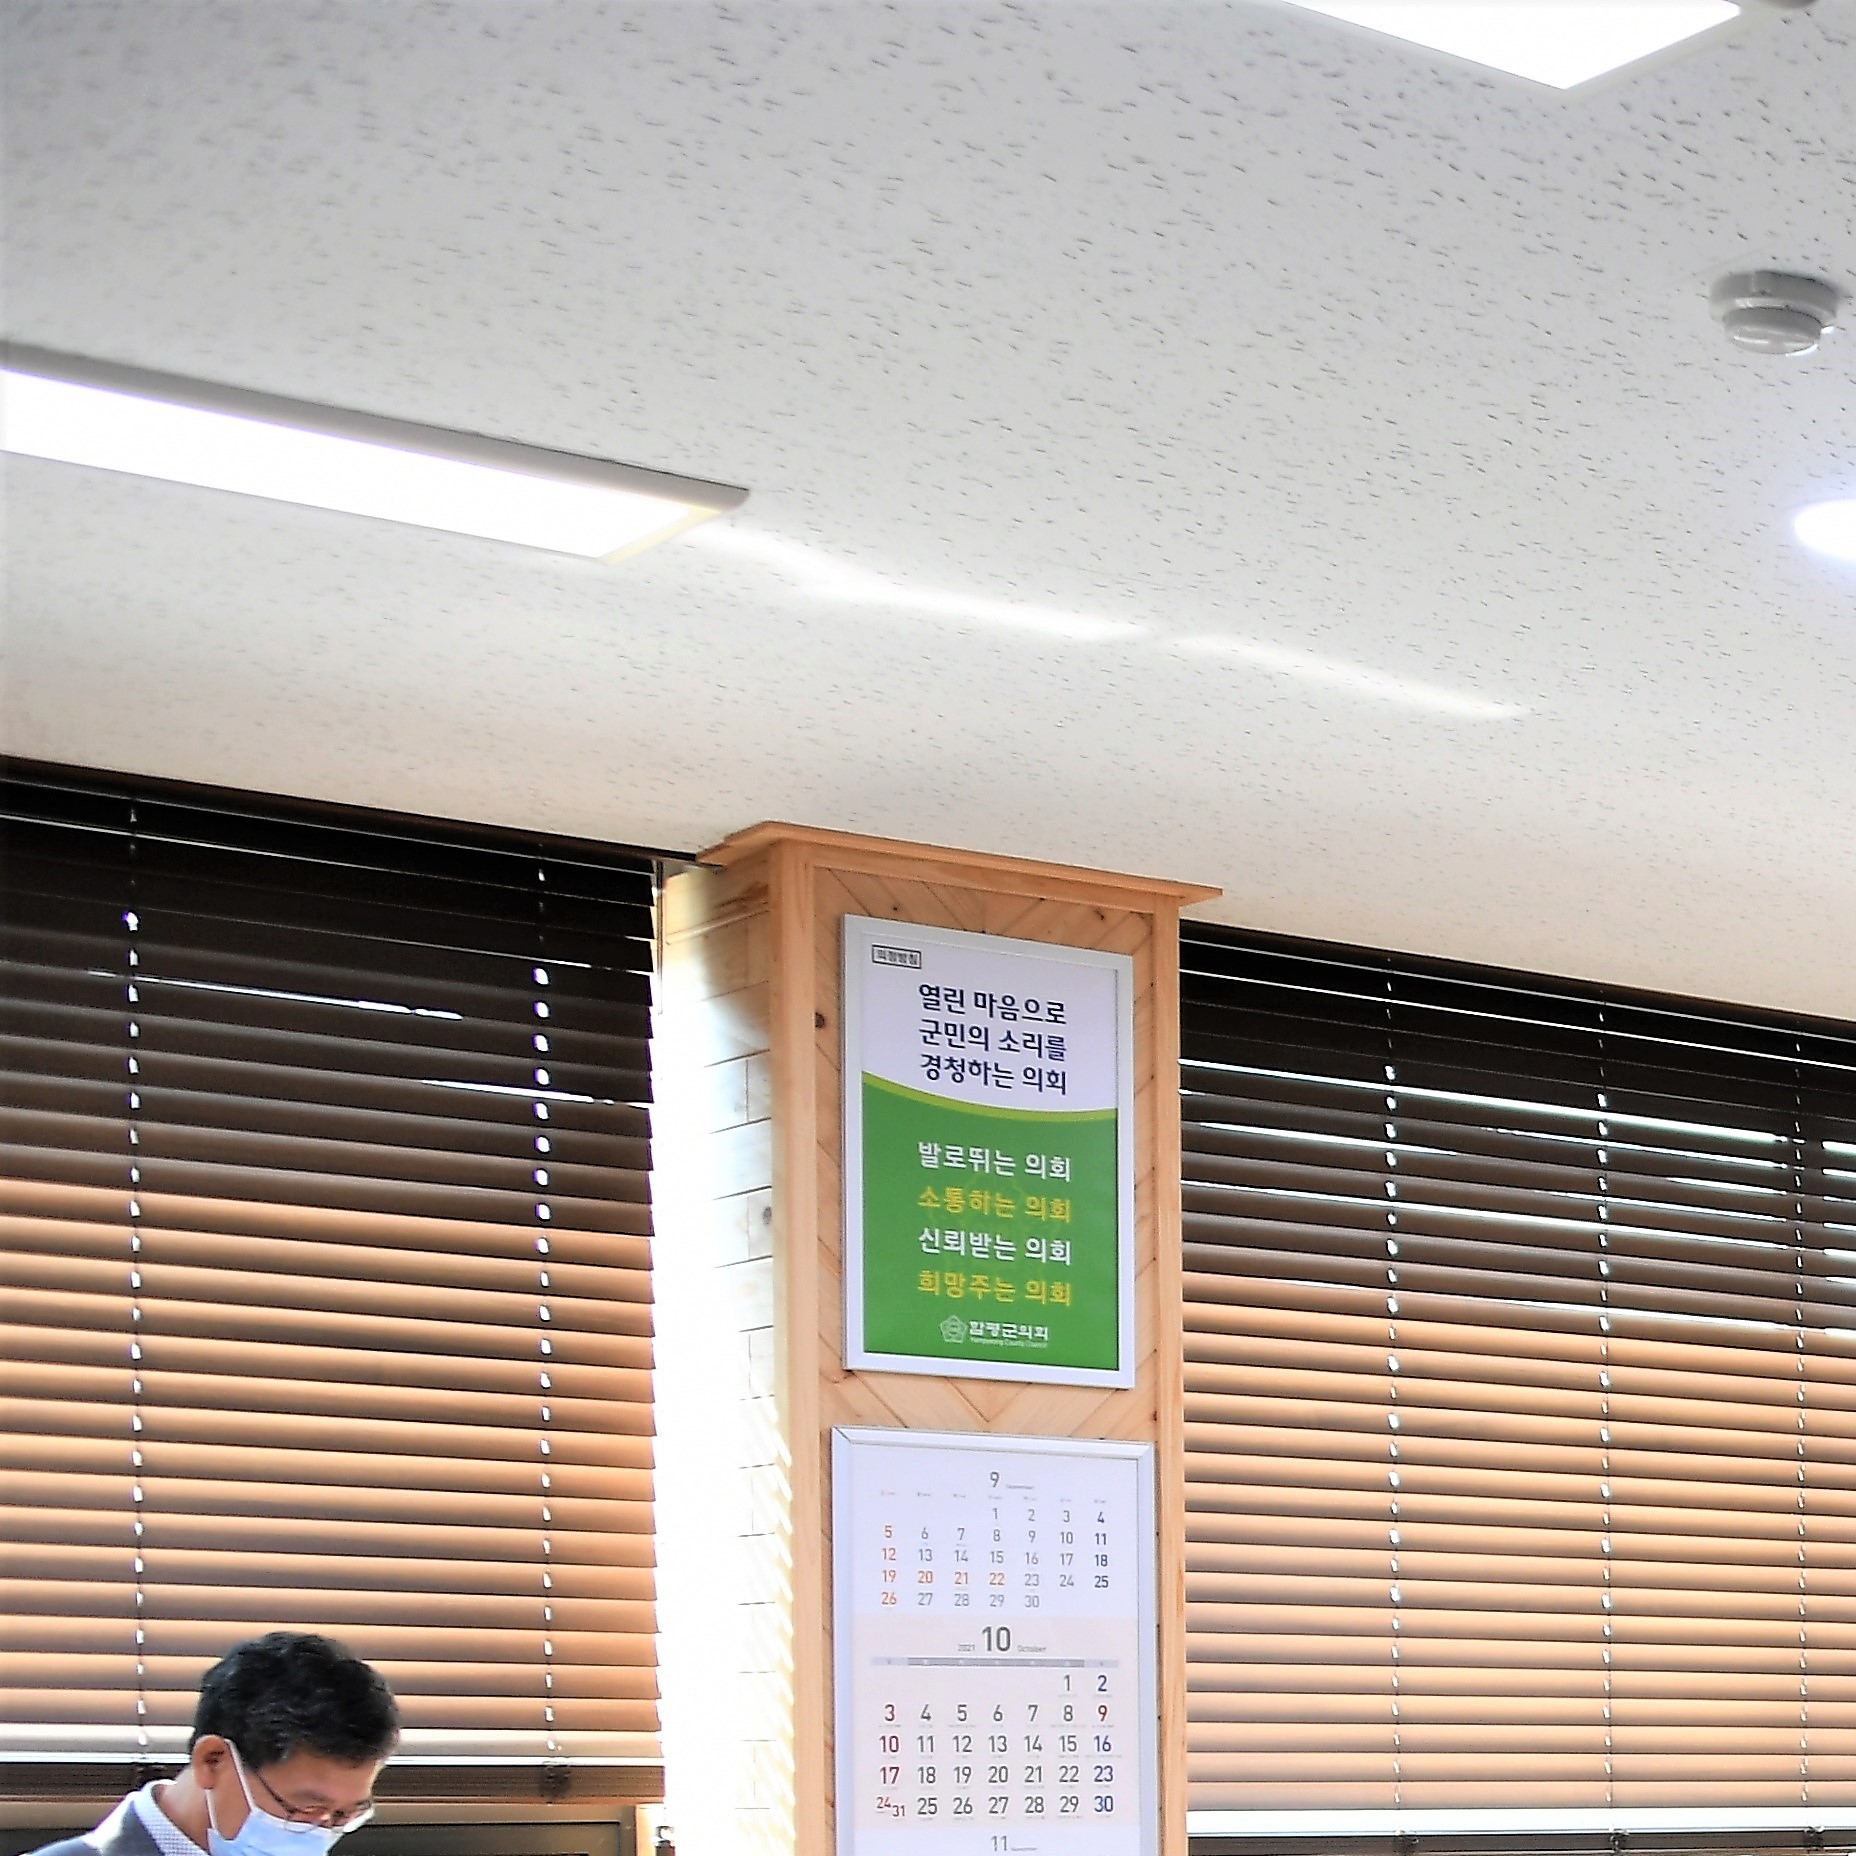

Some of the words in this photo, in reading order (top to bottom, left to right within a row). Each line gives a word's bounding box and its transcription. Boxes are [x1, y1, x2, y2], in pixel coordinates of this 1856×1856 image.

[918, 983, 964, 1014] 열린
[974, 993, 1067, 1025] 마음으로
[918, 1018, 989, 1051] 군민의
[998, 1030, 1067, 1061] 소리를
[920, 1054, 1015, 1089] 경청하는
[1022, 1068, 1066, 1096] 의회
[918, 1141, 1016, 1178] 발로뛰는
[1025, 1154, 1071, 1182] 의회
[918, 1186, 1016, 1219] 소통하는
[1025, 1196, 1071, 1224] 의회
[918, 1228, 1016, 1263] 신뢰받는
[1025, 1237, 1071, 1265] 의회
[918, 1271, 1016, 1304] 희망주는
[1025, 1279, 1071, 1306] 의회
[989, 1471, 1000, 1488] 9
[1060, 1531, 1074, 1545] 10
[1094, 1532, 1107, 1546] 11
[882, 1547, 897, 1561] 12
[918, 1548, 933, 1562] 13
[954, 1549, 969, 1563] 14
[990, 1550, 1004, 1564] 15
[1025, 1551, 1039, 1565] 16
[1060, 1552, 1074, 1566] 17
[1094, 1554, 1108, 1567] 18
[882, 1569, 897, 1583] 19
[917, 1570, 934, 1584] 20
[954, 1571, 968, 1585] 21
[989, 1572, 1005, 1586] 22
[1024, 1573, 1040, 1587] 23
[1059, 1574, 1075, 1588] 24
[1094, 1575, 1109, 1589] 25
[881, 1591, 897, 1605] 26
[917, 1592, 934, 1606] 27
[954, 1593, 970, 1607] 28
[989, 1594, 1005, 1608] 29
[1024, 1594, 1040, 1609] 30
[981, 1626, 1012, 1652] 10
[1063, 1674, 1070, 1692] 1
[1097, 1674, 1108, 1692] 2
[884, 1703, 895, 1722] 3
[920, 1703, 932, 1721] 4
[957, 1704, 968, 1722] 5
[993, 1704, 1003, 1722] 6
[1027, 1704, 1039, 1722] 7
[1063, 1704, 1074, 1722] 8
[1097, 1704, 1108, 1722] 9
[879, 1735, 900, 1753] 10
[917, 1735, 934, 1753] 11
[952, 1735, 973, 1753] 12
[988, 1735, 1008, 1753] 13
[1024, 1734, 1043, 1753] 14
[1059, 1734, 1077, 1753] 15
[1093, 1735, 1112, 1752] 16
[880, 1766, 900, 1785] 17
[917, 1766, 936, 1784] 18
[953, 1766, 972, 1784] 19
[988, 1765, 1009, 1784] 20
[1024, 1765, 1042, 1783] 21
[1059, 1765, 1080, 1783] 22
[1094, 1765, 1114, 1783] 23
[876, 1796, 892, 1809] 24
[892, 1805, 905, 1817] 31
[917, 1797, 938, 1815] 25
[953, 1797, 973, 1815] 26
[988, 1796, 1009, 1815] 27
[1024, 1796, 1045, 1814] 28
[1059, 1795, 1080, 1813] 29
[1094, 1795, 1114, 1813] 30
[990, 1835, 1008, 1852] 11
